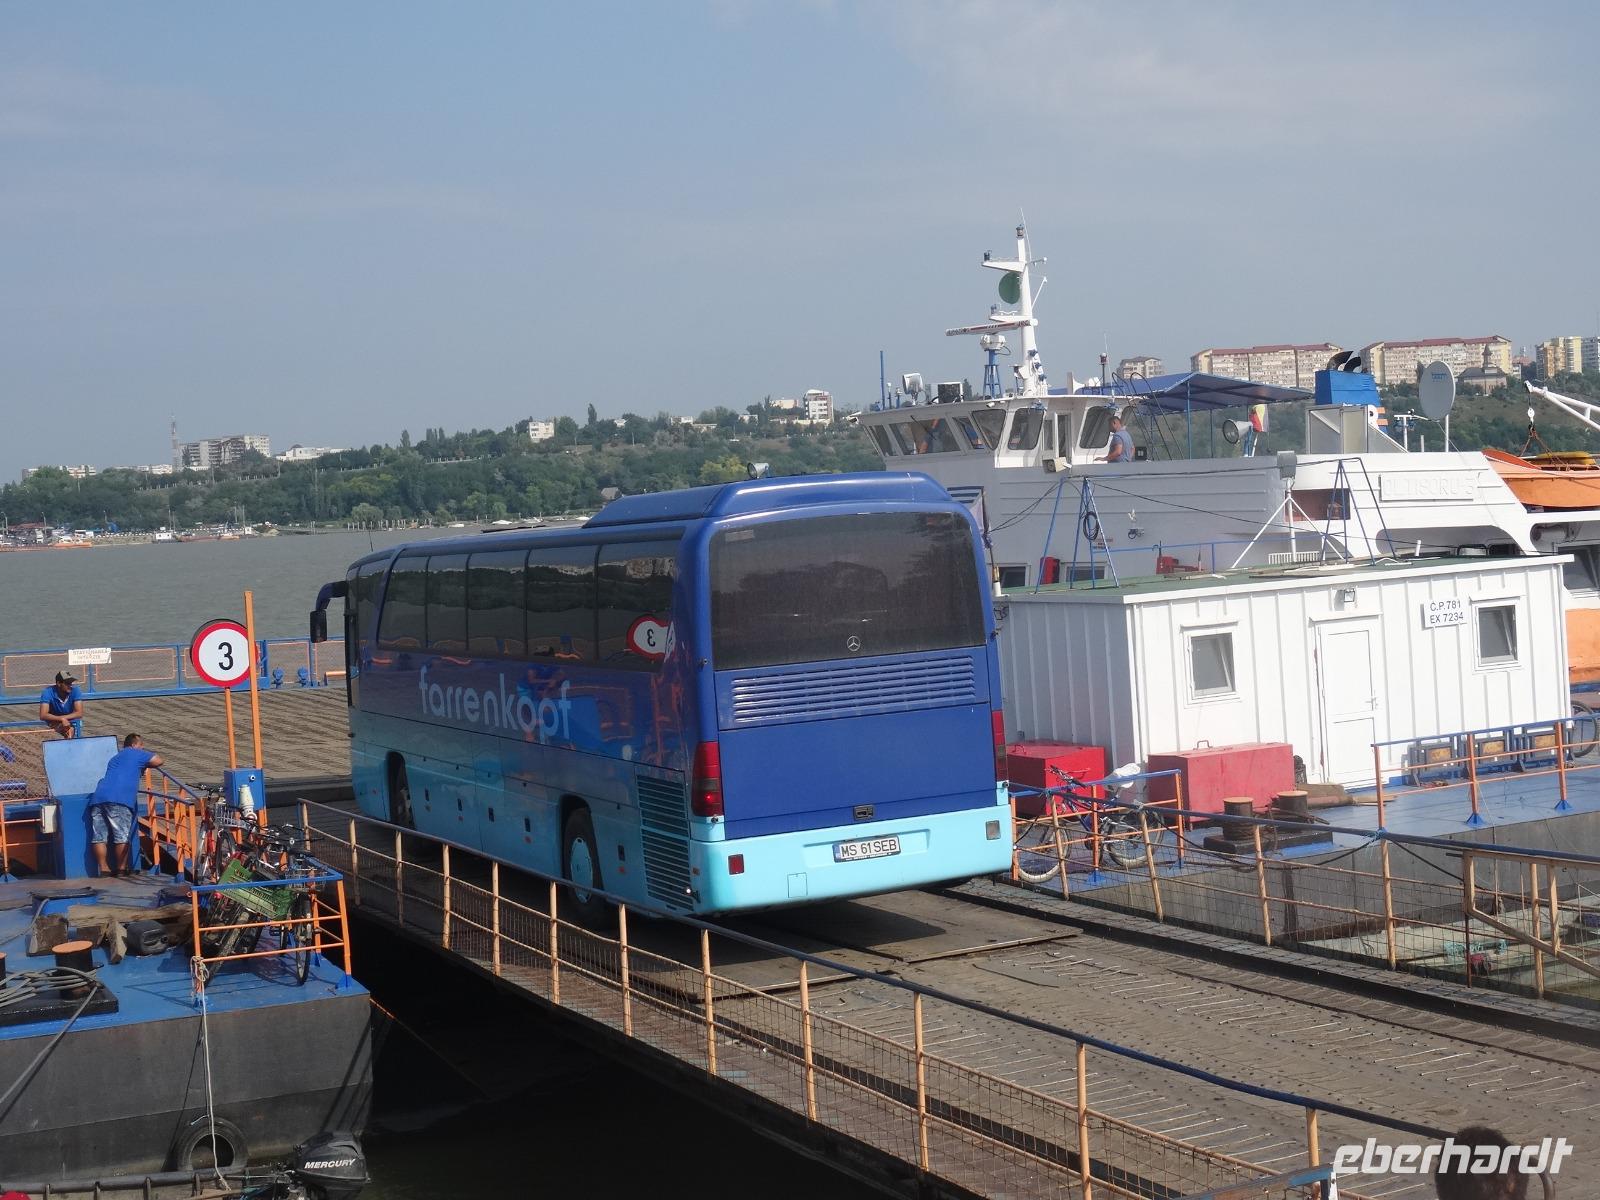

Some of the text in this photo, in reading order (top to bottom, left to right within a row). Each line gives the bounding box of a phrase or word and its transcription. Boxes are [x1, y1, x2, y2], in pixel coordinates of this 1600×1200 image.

[1430, 611, 1464, 624] EX 7234
[218, 641, 234, 671] 3
[418, 664, 572, 744] farrenkopf
[841, 844, 858, 857] MS
[860, 842, 872, 854] 61
[873, 839, 897, 853] SEB
[304, 1158, 356, 1169] MERCURY
